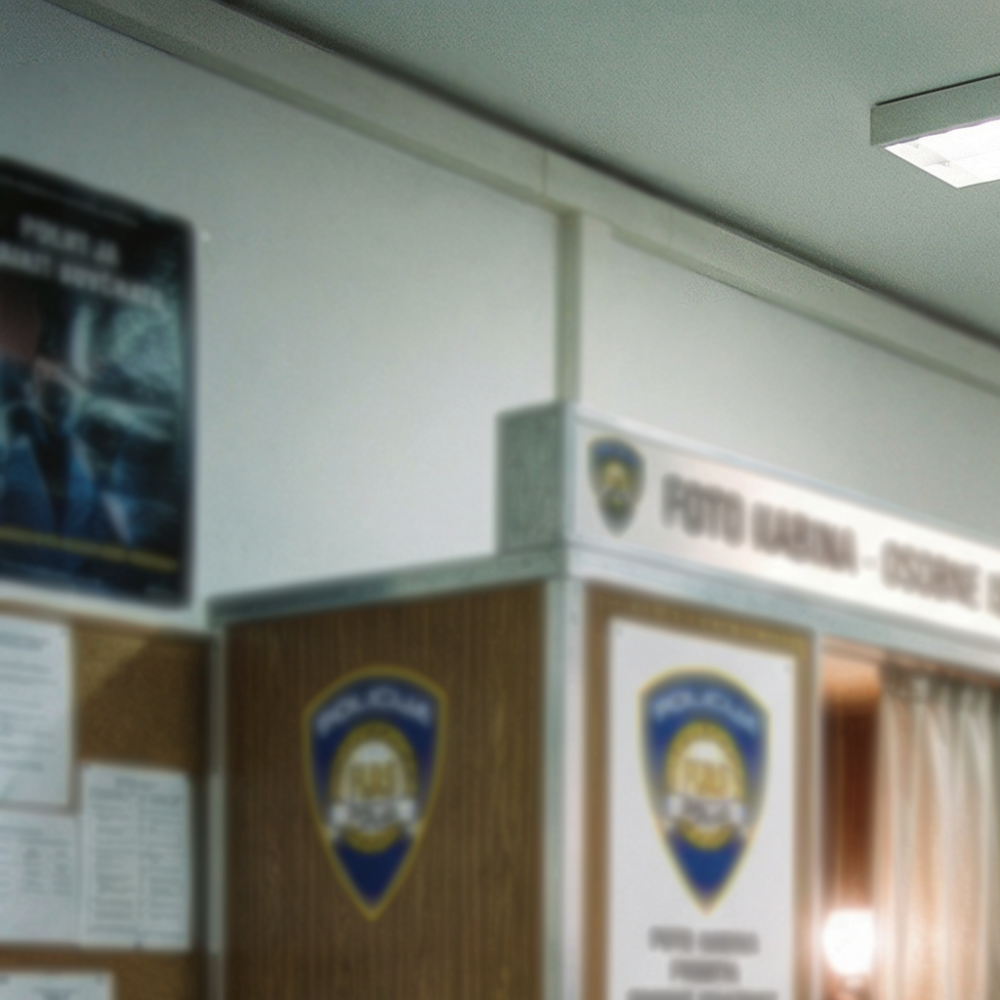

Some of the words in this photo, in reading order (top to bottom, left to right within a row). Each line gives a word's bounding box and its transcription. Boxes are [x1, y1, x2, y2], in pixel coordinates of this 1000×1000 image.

[663, 475, 743, 545] FOTO
[754, 504, 857, 576] KABINA
[882, 541, 980, 609] OSOBNE
